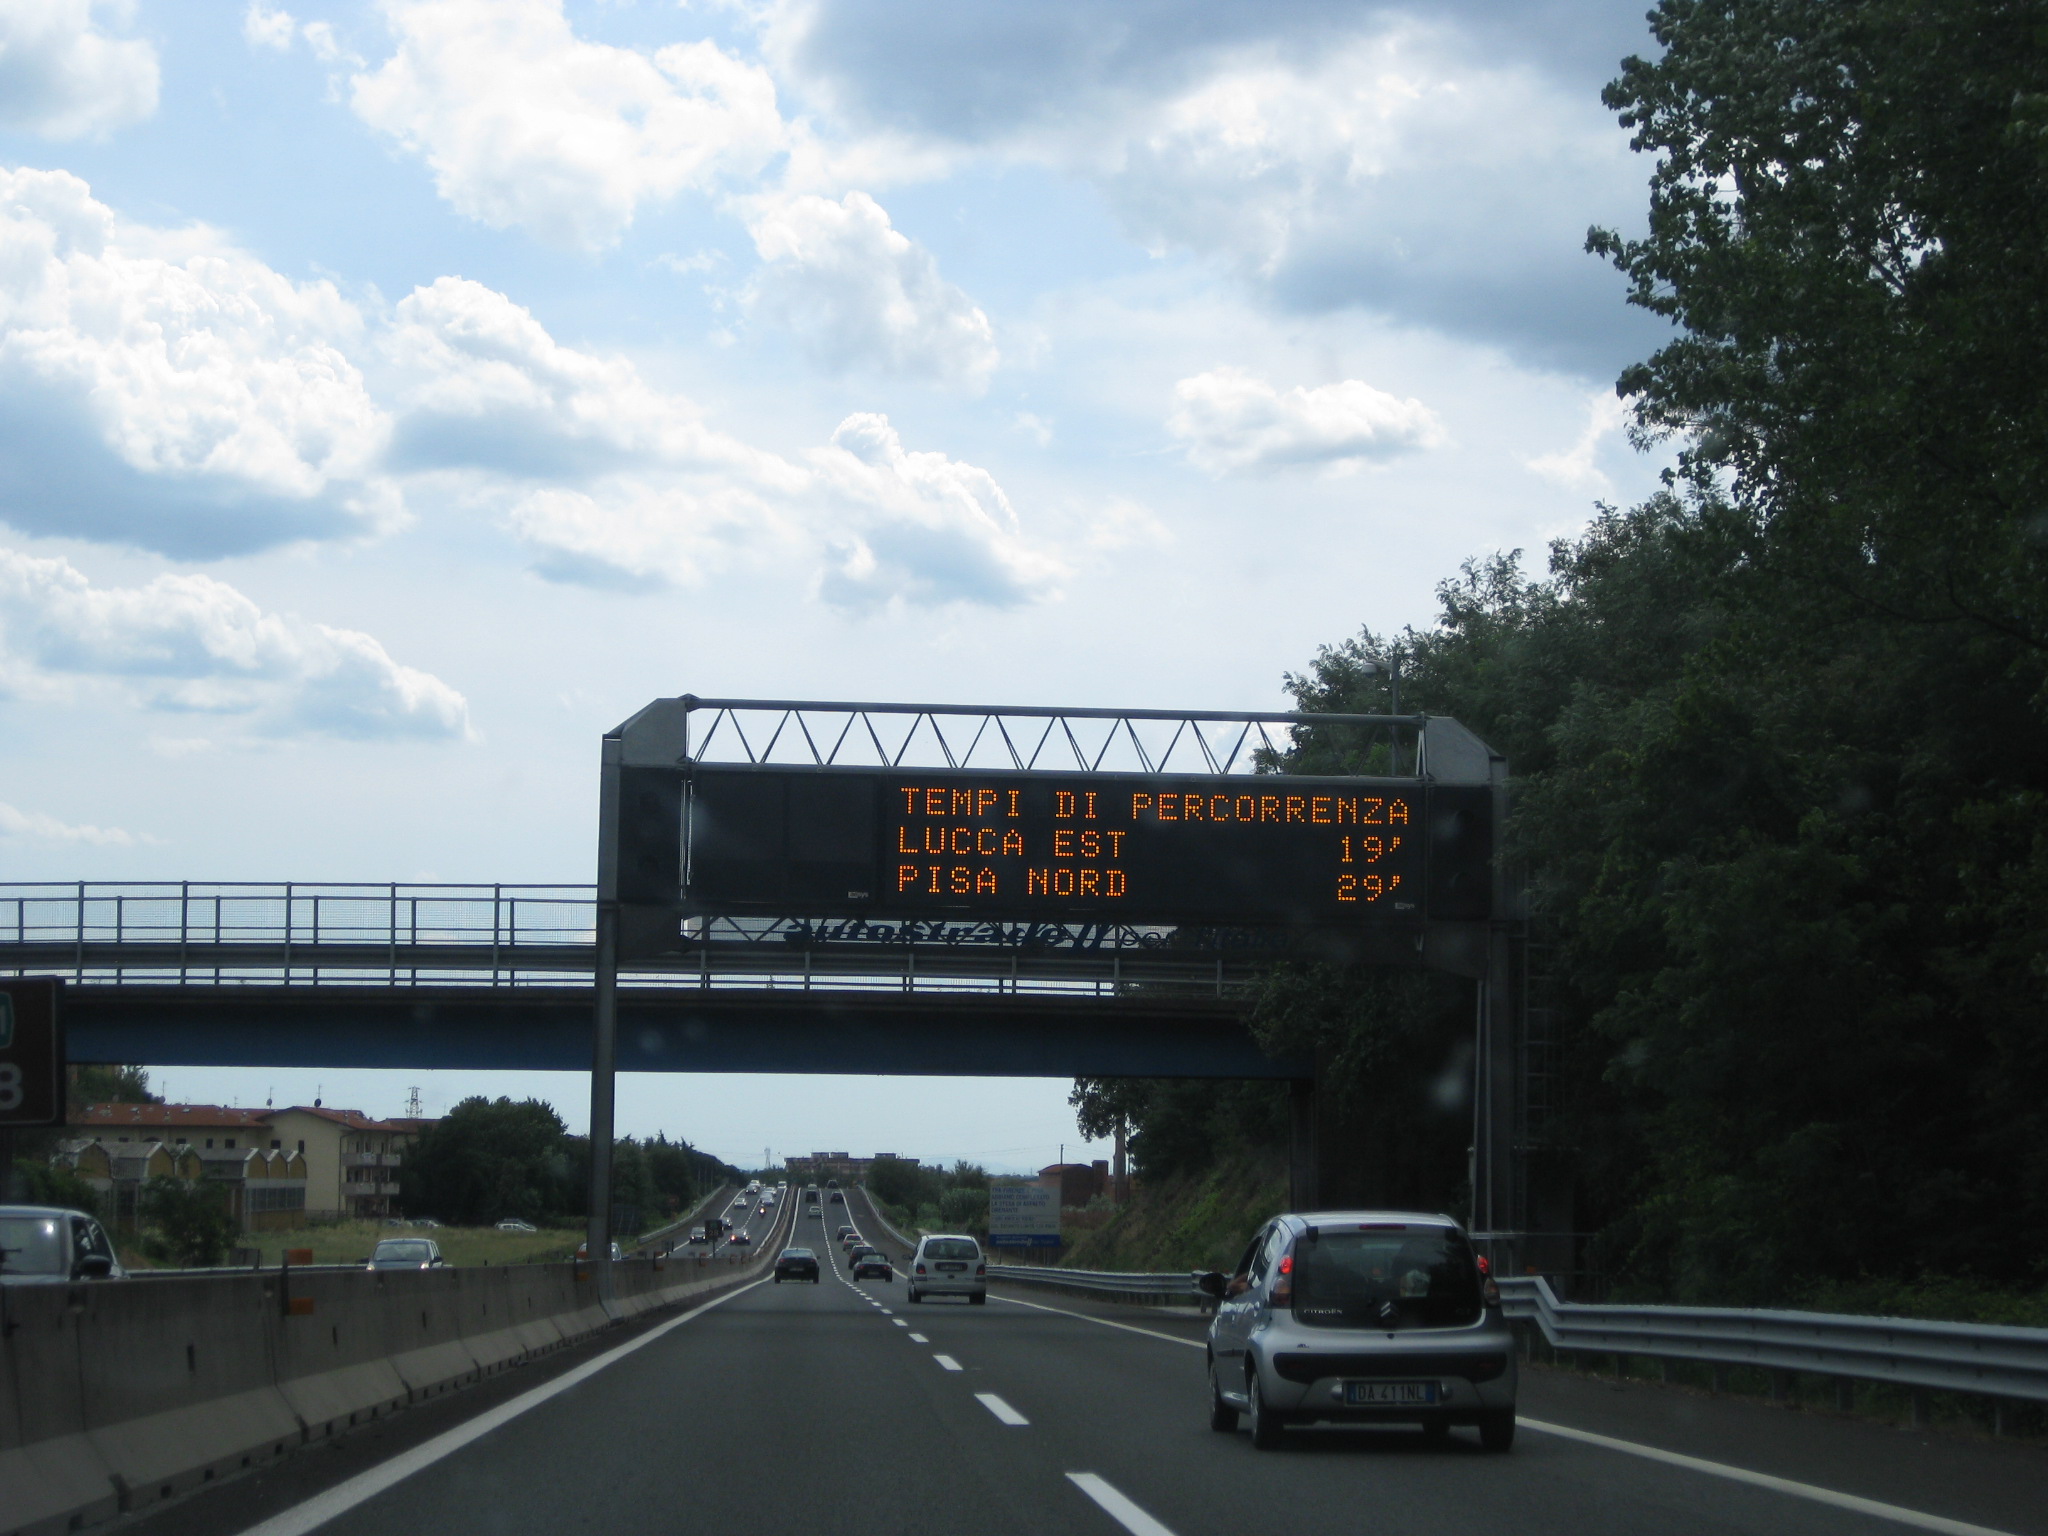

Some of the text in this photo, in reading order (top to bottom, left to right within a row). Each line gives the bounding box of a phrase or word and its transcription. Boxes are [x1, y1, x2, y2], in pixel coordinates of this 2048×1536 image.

[901, 787, 1409, 825] TEMPI DI PERCORRENZA
[899, 826, 1024, 856] LUCCA
[1054, 829, 1126, 858] EST
[898, 864, 998, 894] PISA
[1028, 868, 1127, 897] NORD
